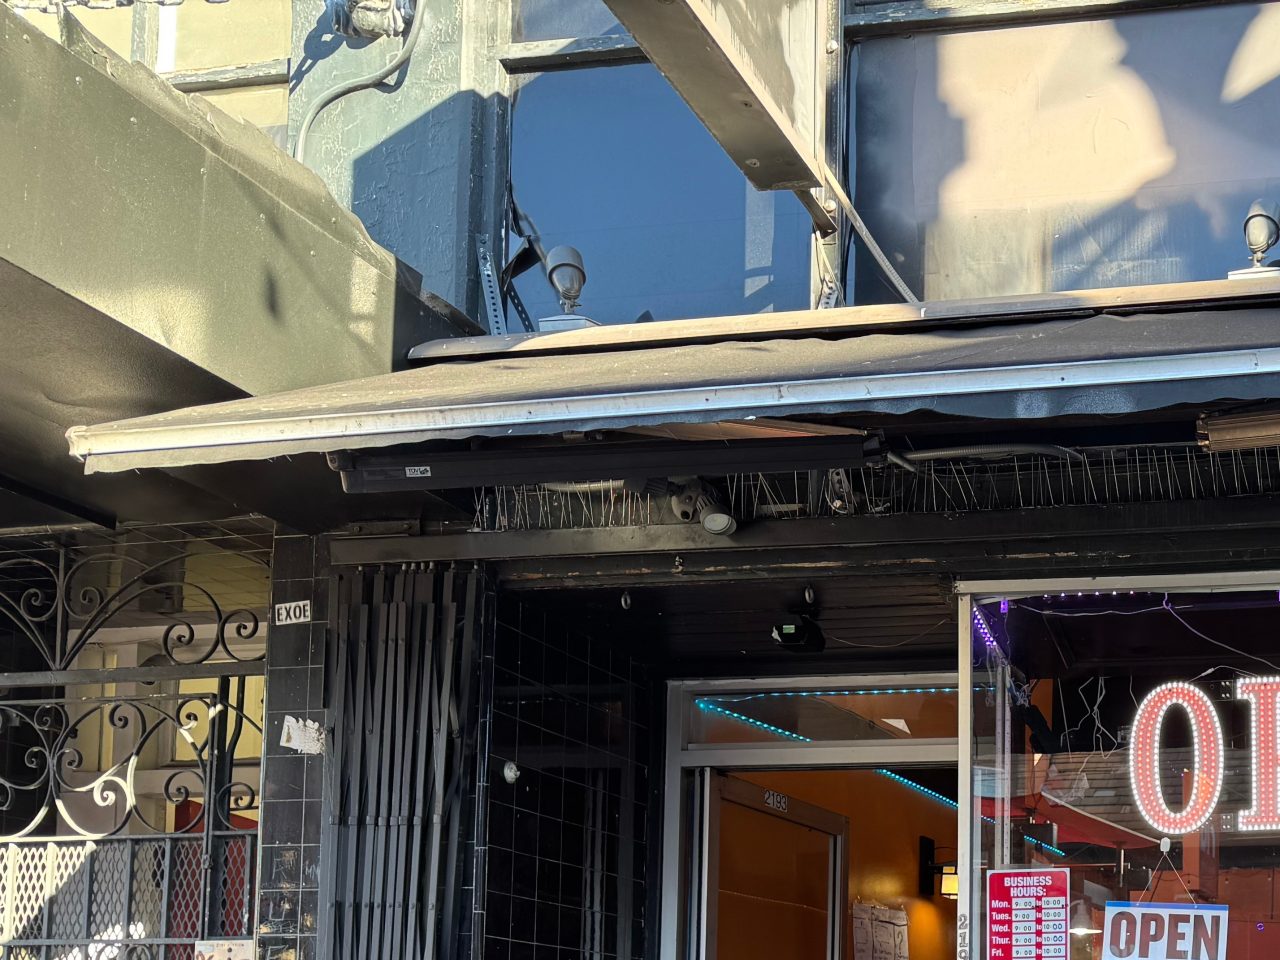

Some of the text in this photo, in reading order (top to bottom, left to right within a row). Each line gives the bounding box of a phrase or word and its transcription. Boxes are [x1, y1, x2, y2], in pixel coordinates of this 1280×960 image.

[276, 603, 309, 623] EXOE
[1004, 876, 1052, 886] BUSINESS
[1010, 887, 1046, 897] HOURS:
[1110, 911, 1220, 960] OPEN
